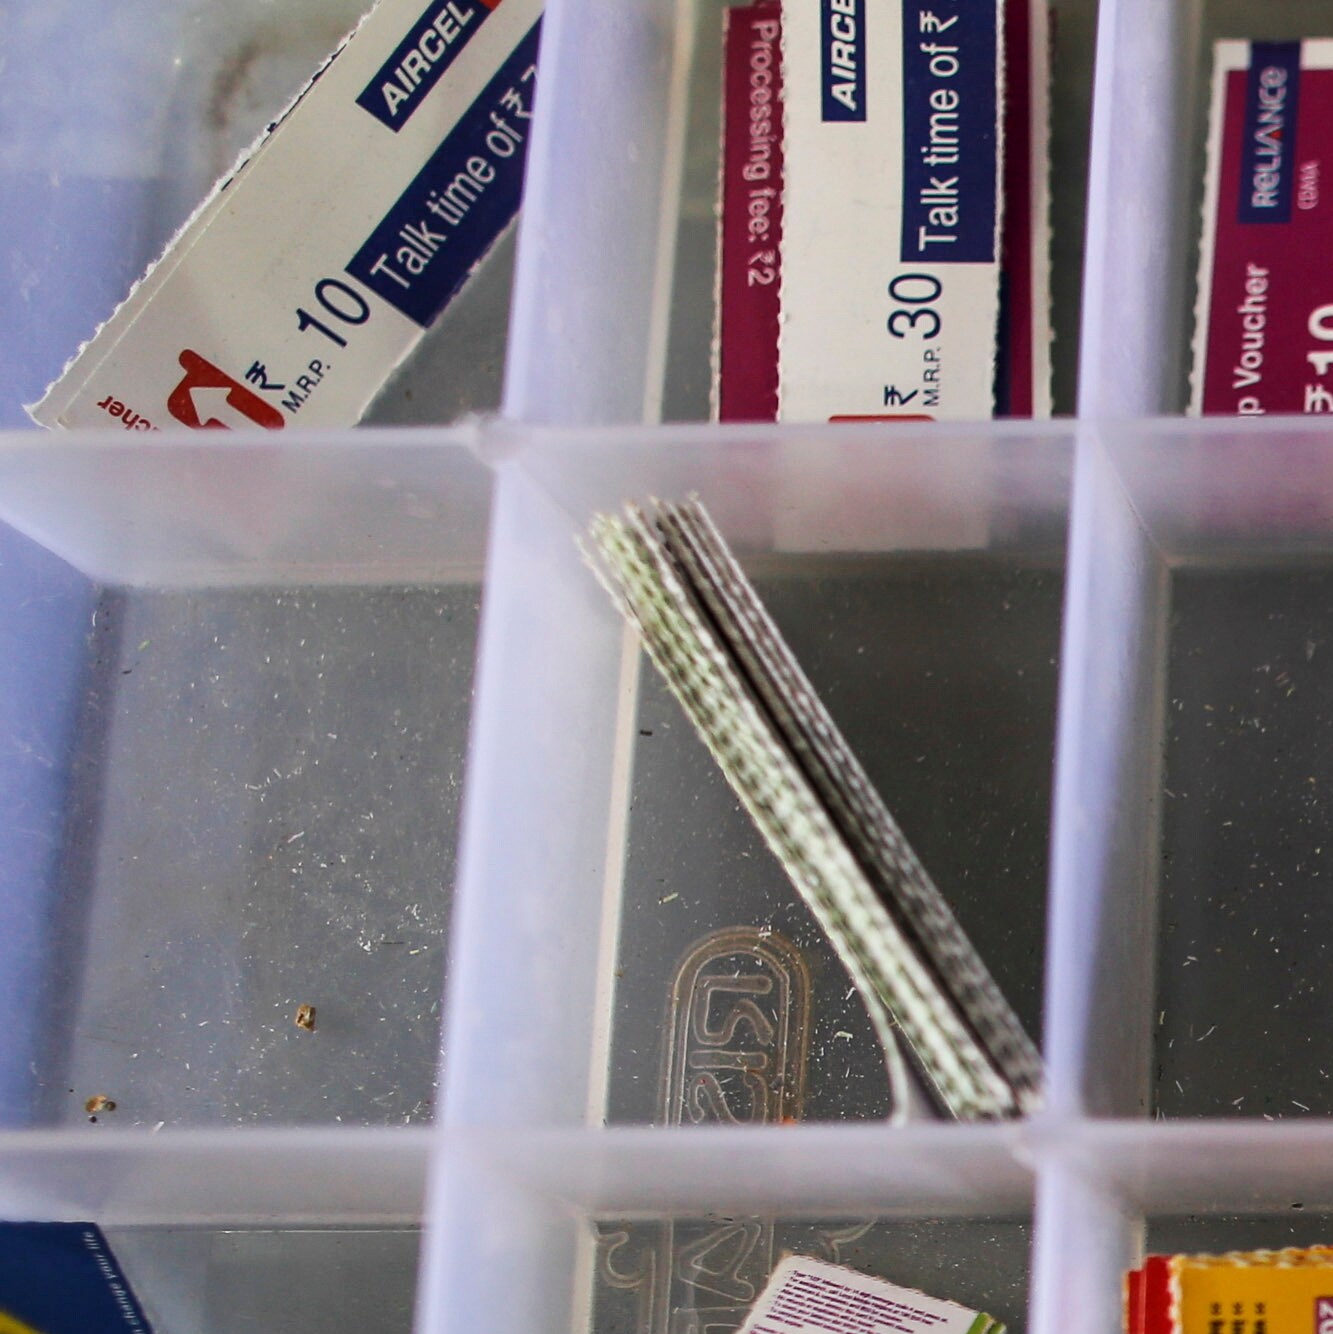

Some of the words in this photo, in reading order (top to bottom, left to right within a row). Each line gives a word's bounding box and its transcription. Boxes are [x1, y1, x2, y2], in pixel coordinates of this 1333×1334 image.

[377, 0, 476, 116] AIRCEL
[920, 42, 959, 76] of
[742, 19, 775, 180] Processing
[920, 89, 959, 167] time
[369, 218, 446, 293] Talk
[426, 155, 497, 227] time
[487, 115, 524, 157] of
[748, 189, 775, 242] fee:
[918, 177, 959, 251] Talk
[296, 277, 371, 348] 10
[888, 273, 943, 340] 30
[1233, 264, 1270, 389] Voucher
[281, 360, 332, 414] M.R.P.
[923, 347, 940, 407] M.R.P.
